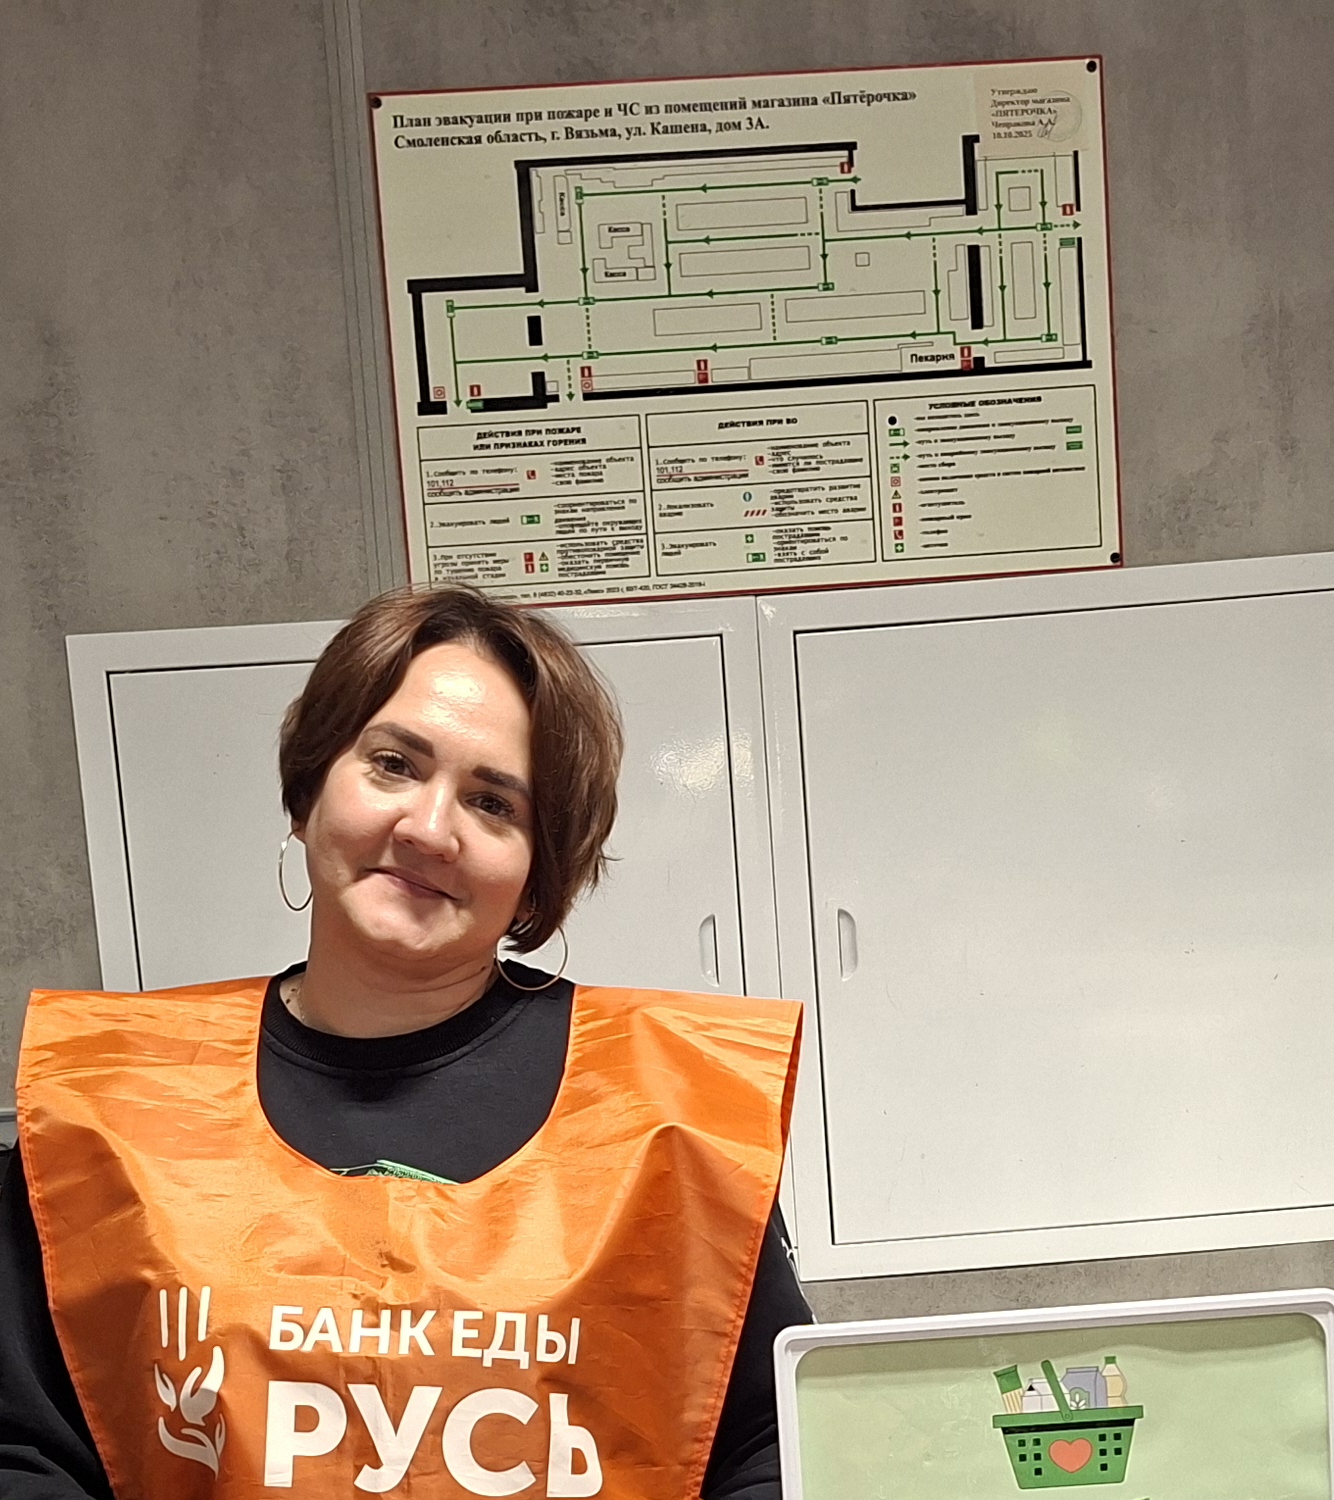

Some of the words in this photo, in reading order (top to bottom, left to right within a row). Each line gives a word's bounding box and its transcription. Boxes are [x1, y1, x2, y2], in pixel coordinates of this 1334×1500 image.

[392, 114, 431, 129] План
[435, 112, 512, 128] эвакуации
[515, 111, 543, 125] при
[546, 107, 601, 122] пожаре
[604, 107, 613, 118] и
[616, 102, 640, 117] ЧС
[644, 104, 661, 116] из
[664, 97, 748, 115] помещений
[751, 94, 819, 110] магазина
[821, 89, 917, 107] «Пятёрочка»
[394, 132, 483, 150] Смоленская
[486, 128, 547, 146] область,
[550, 130, 561, 141] г.
[564, 125, 622, 143] Вязьма,
[624, 124, 646, 141] ул.
[650, 120, 712, 137] Кашена,
[715, 120, 743, 135] дом
[745, 116, 770, 132] 3А.
[910, 353, 956, 364] Пекарня
[525, 428, 543, 437] ПРИ
[268, 1304, 437, 1357] БАНК
[451, 1310, 581, 1370] ЕДЫ
[263, 1380, 604, 1500] РУСЬ
